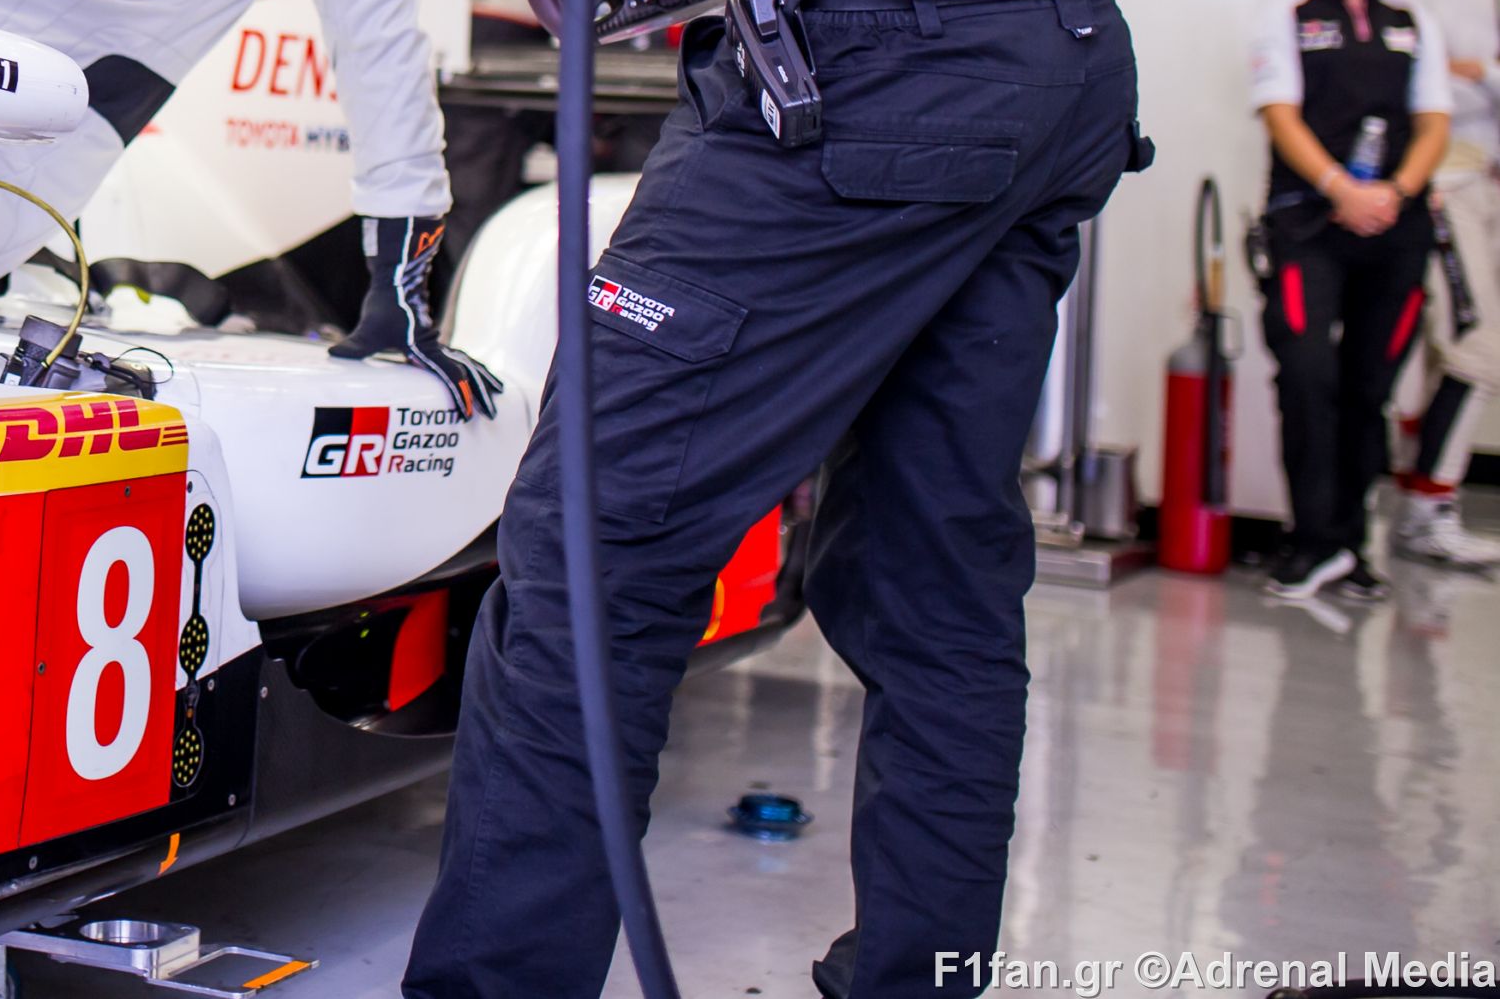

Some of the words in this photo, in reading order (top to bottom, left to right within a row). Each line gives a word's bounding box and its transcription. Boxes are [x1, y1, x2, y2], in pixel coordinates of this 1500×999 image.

[231, 28, 338, 103] DEN
[616, 296, 665, 322] GAZOO
[622, 287, 675, 317] TOYOTA
[611, 304, 659, 332] Racing
[303, 430, 387, 476] GR
[393, 432, 459, 450] GAZOO
[387, 454, 455, 477] Racing
[66, 526, 155, 781] 8
